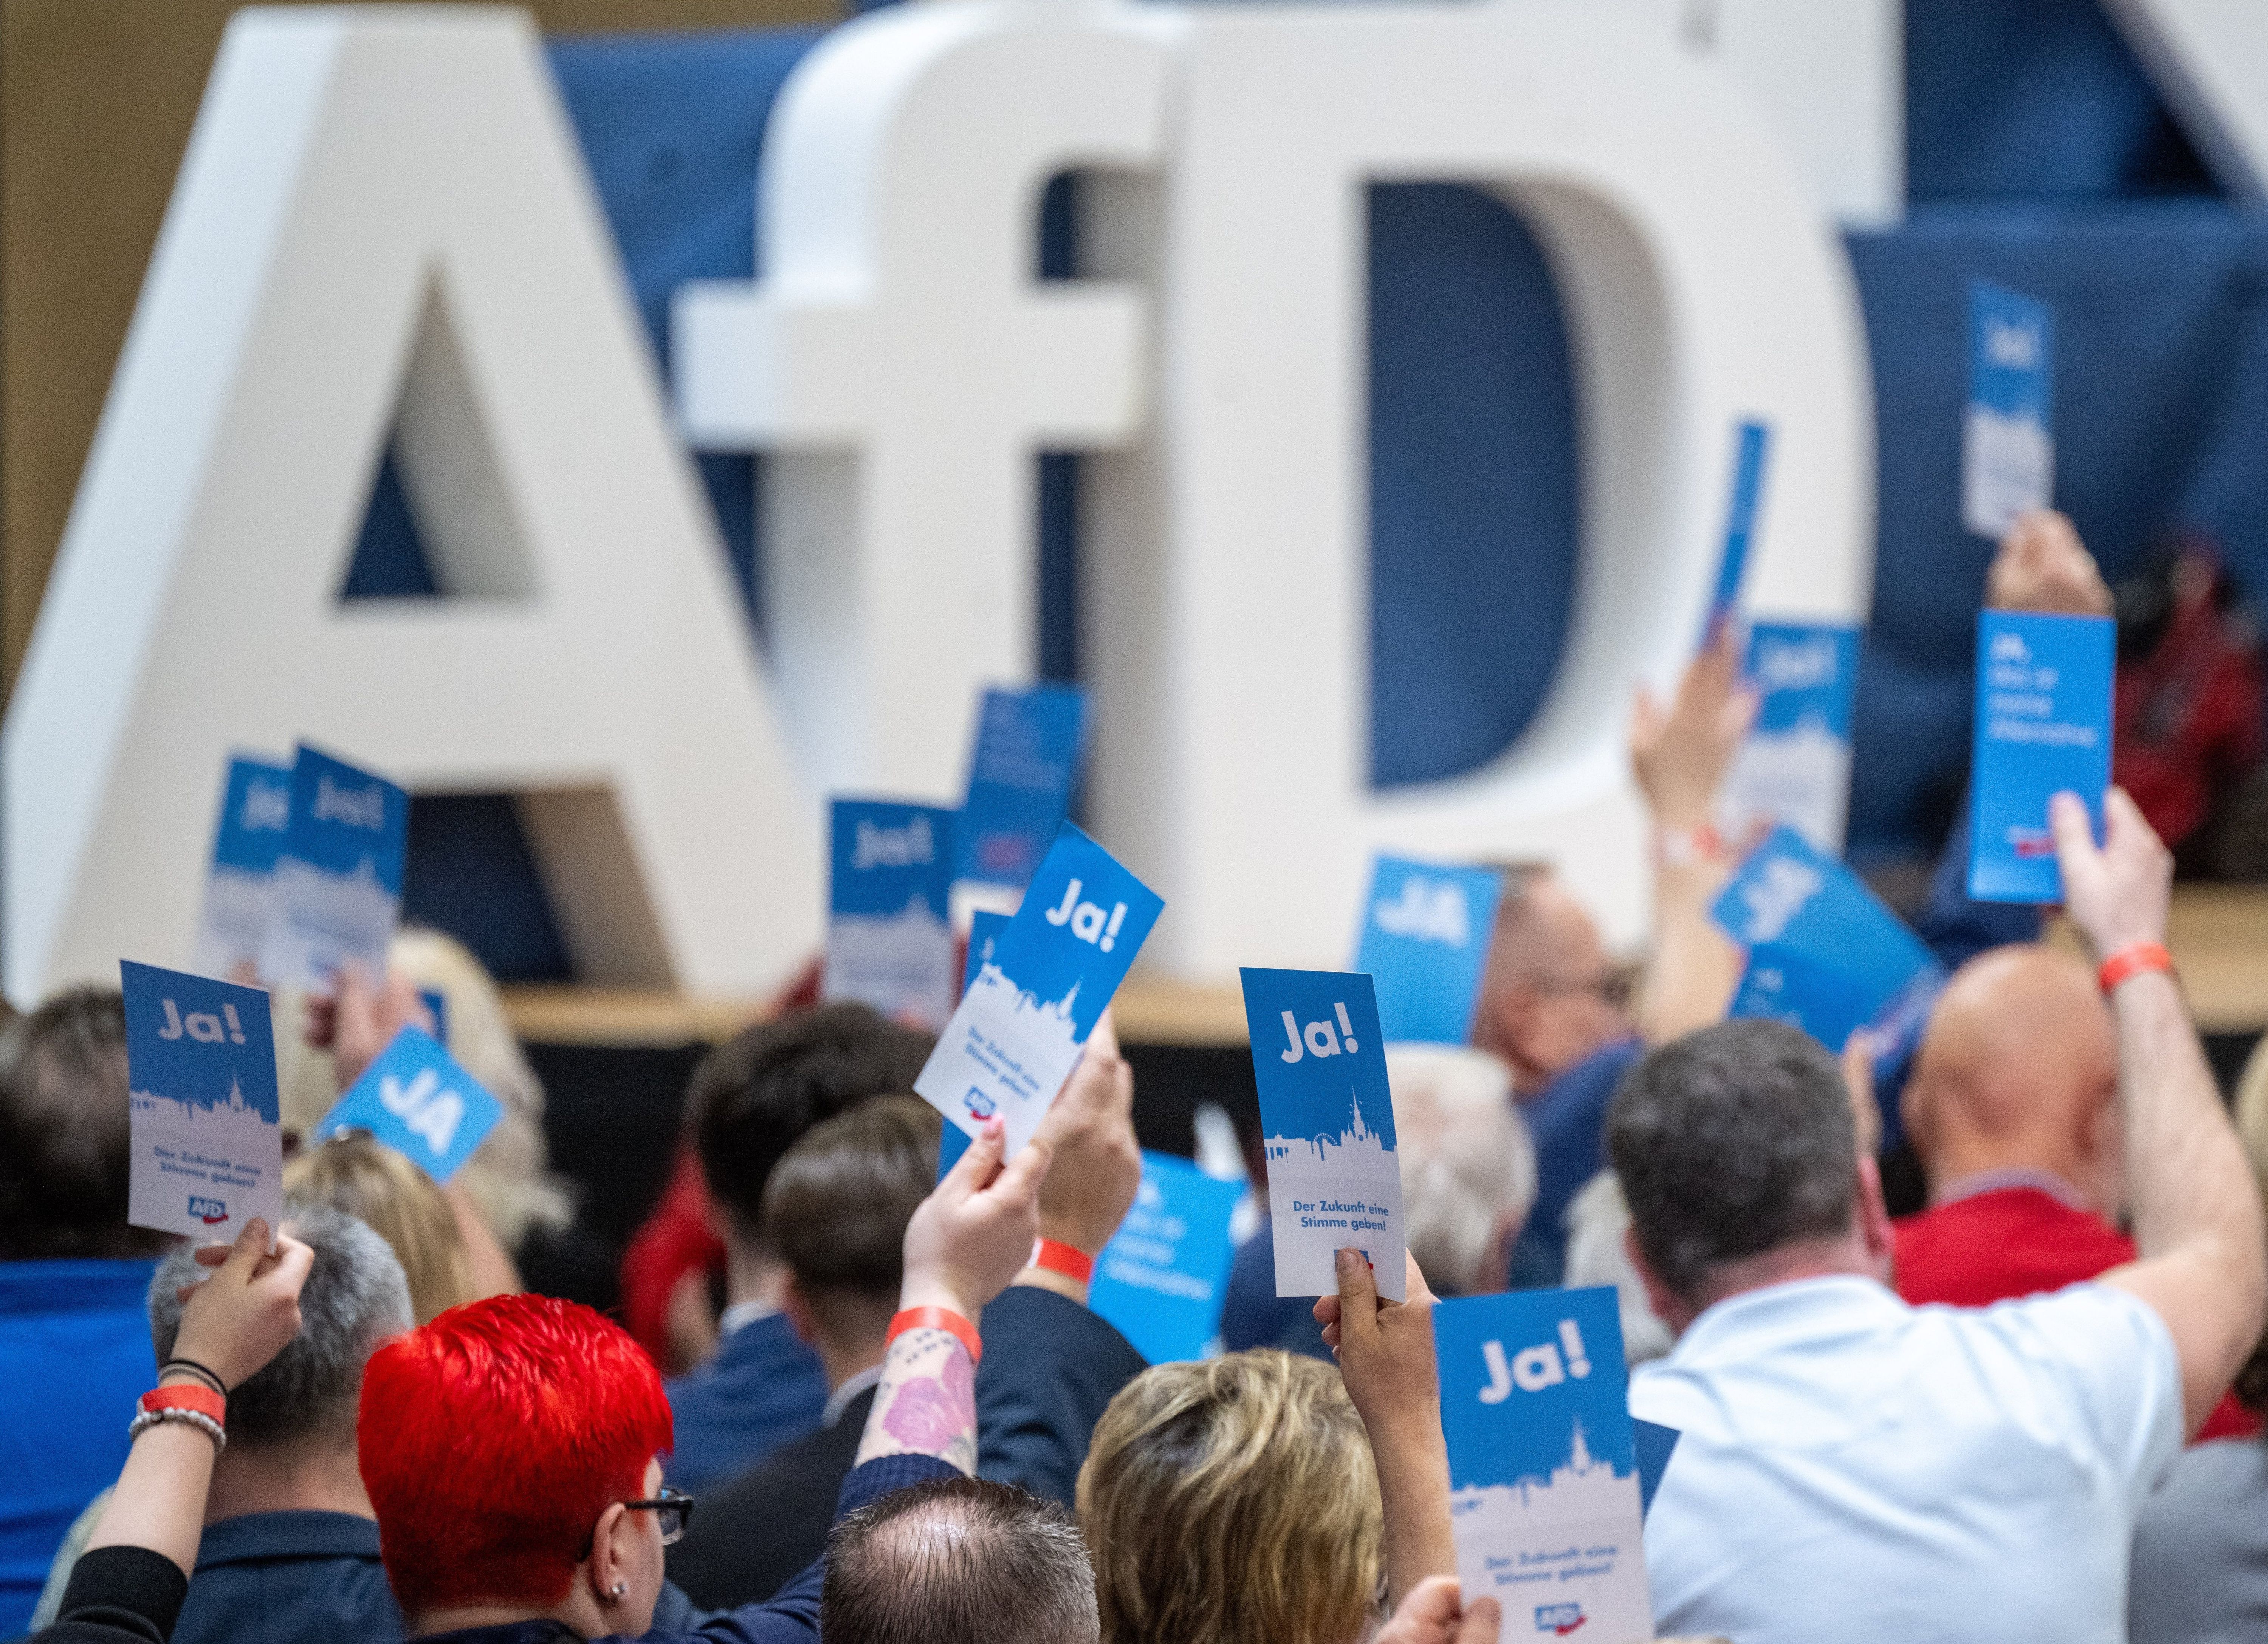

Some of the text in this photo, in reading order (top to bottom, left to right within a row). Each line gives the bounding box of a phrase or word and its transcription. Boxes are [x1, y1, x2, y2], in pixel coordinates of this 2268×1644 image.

[6, 0, 1878, 1002] AfD
[1044, 877, 1128, 953] Ja!
[158, 998, 246, 1045] Ja!
[1280, 1002, 1359, 1063] Ja!
[379, 1067, 465, 1157] JA
[1293, 1200, 1389, 1216] Der Zukunft eine
[1301, 1215, 1387, 1231] Stimme geben!
[1478, 1318, 1592, 1405] Ja!
